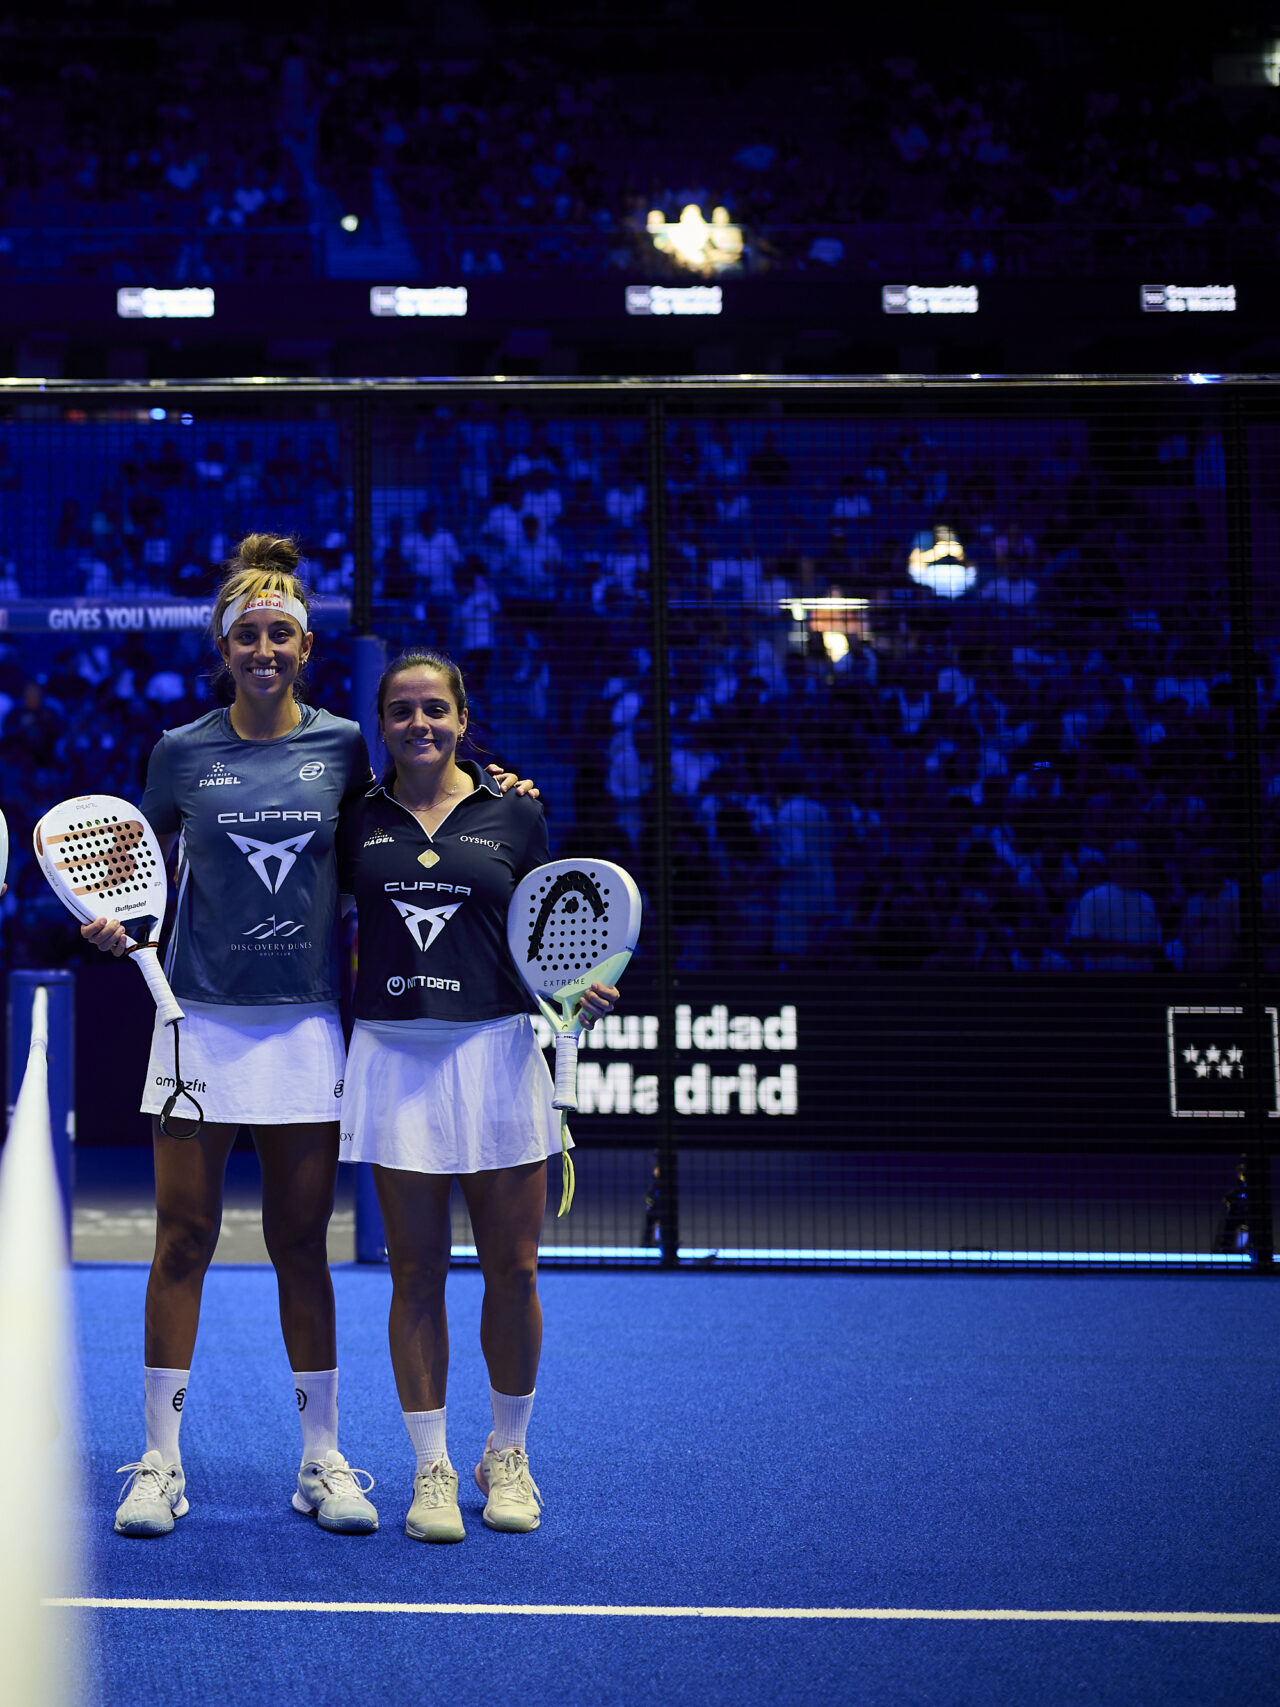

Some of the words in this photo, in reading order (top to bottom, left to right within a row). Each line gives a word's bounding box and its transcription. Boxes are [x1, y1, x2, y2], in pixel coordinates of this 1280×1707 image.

[48, 608, 102, 630] GIVES
[104, 607, 144, 629] YOU
[147, 604, 214, 628] WIIING
[199, 776, 241, 787] PADEL
[217, 810, 322, 824] CUPRA
[363, 836, 396, 848] PADEL
[459, 835, 495, 848] OYSHO
[384, 881, 472, 897] CUPRA
[114, 900, 147, 913] Bullpadel
[230, 943, 286, 951] DISCOVERY
[543, 978, 585, 987] EXTREME
[155, 1076, 207, 1093] amzfit
